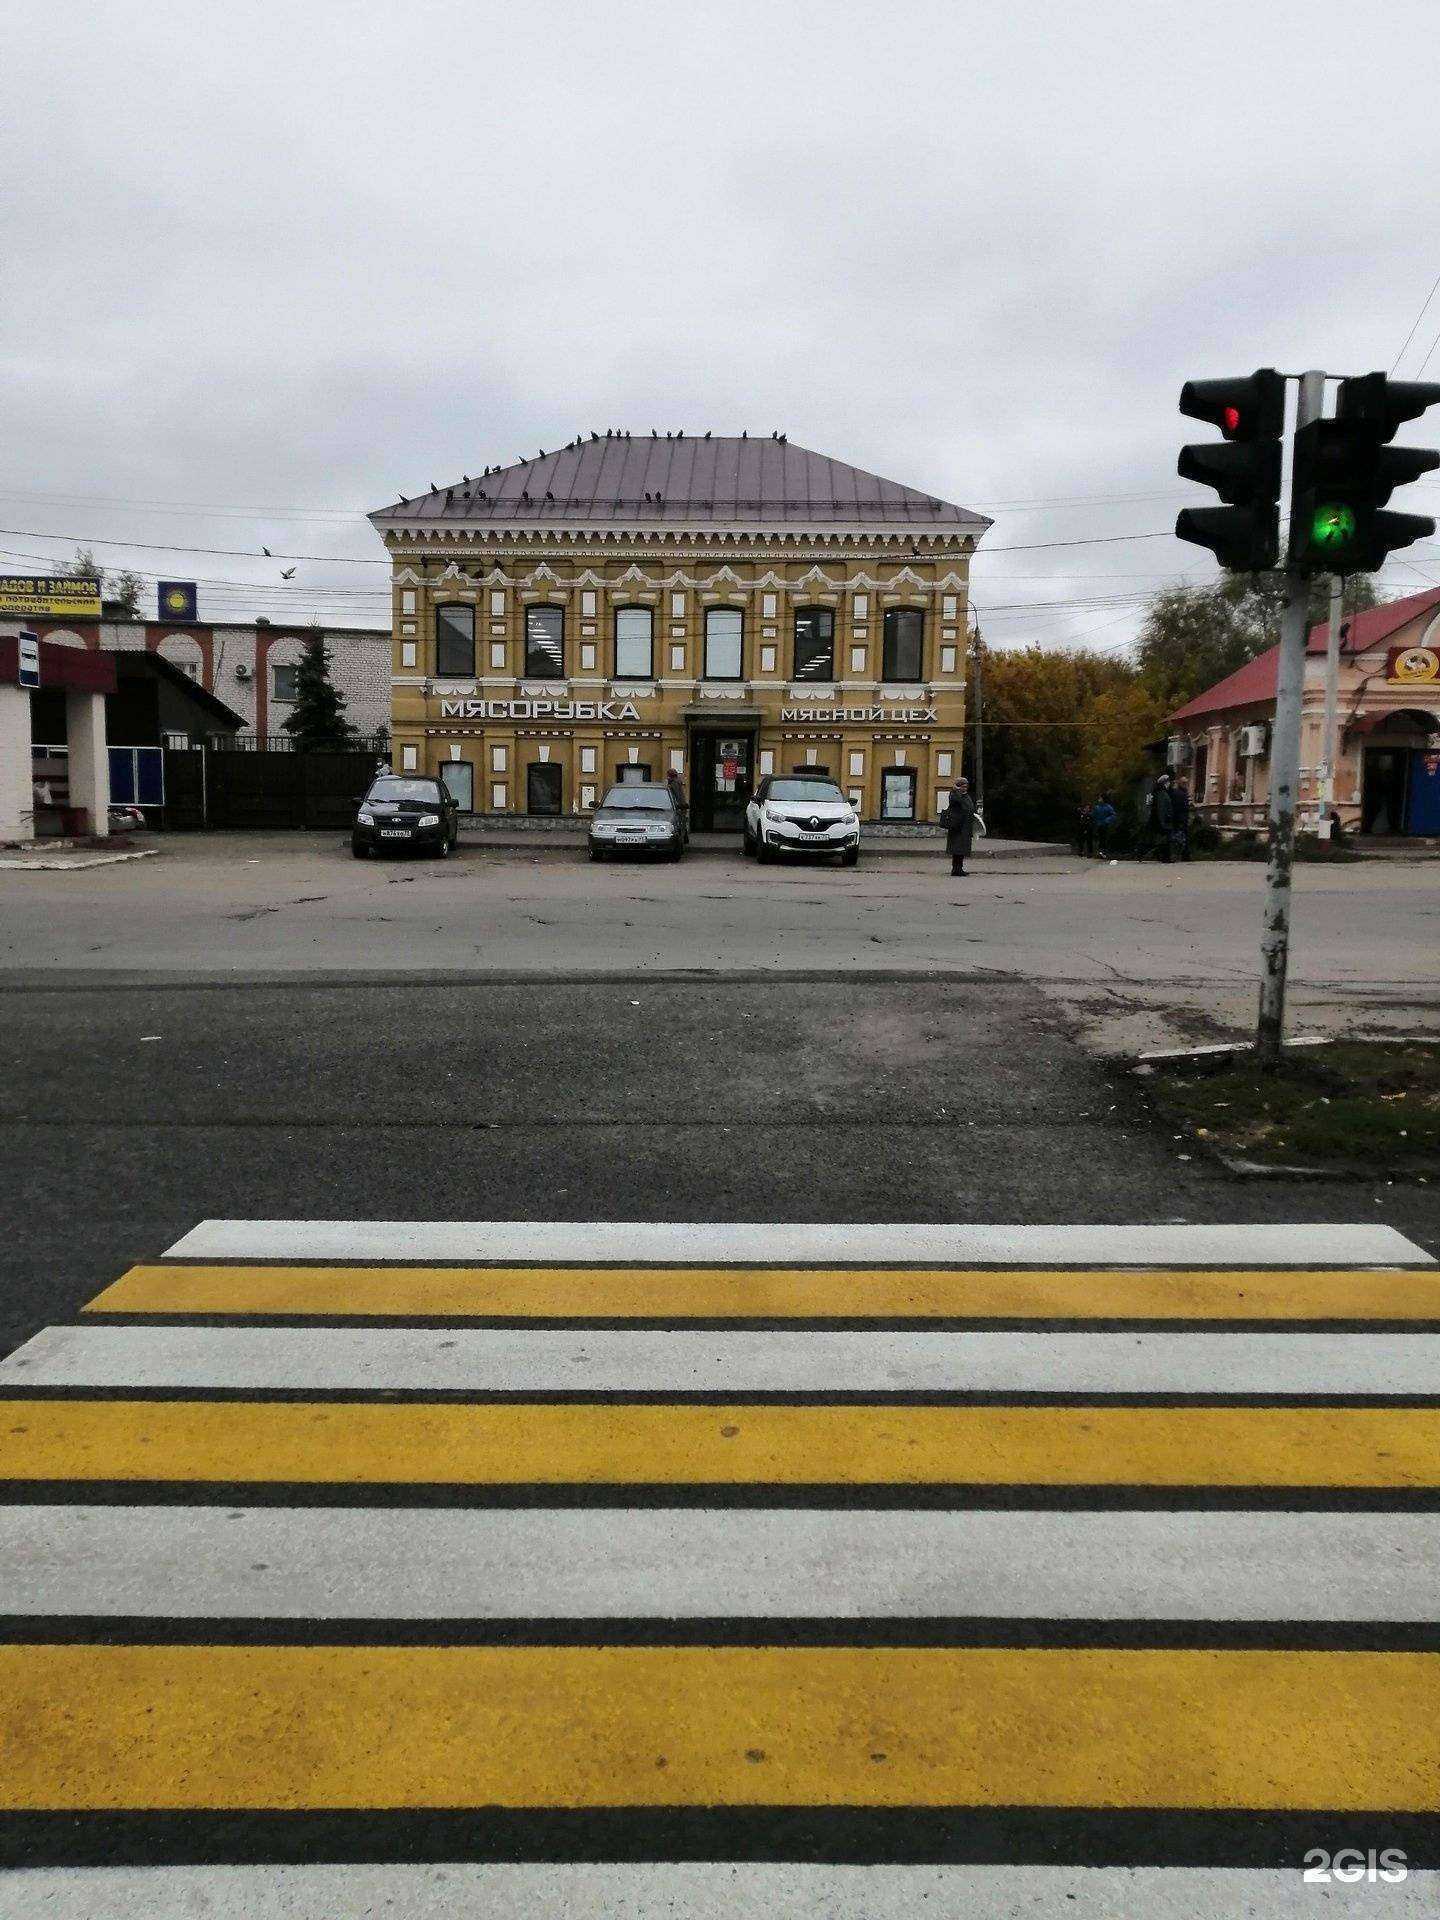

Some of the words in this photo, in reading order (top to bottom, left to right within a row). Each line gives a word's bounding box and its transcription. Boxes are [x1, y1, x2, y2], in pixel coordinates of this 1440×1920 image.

[441, 699, 641, 720] МЯСОРУБКА
[781, 704, 885, 721] МЯСНОЙ
[891, 707, 938, 723] ЦЕХ
